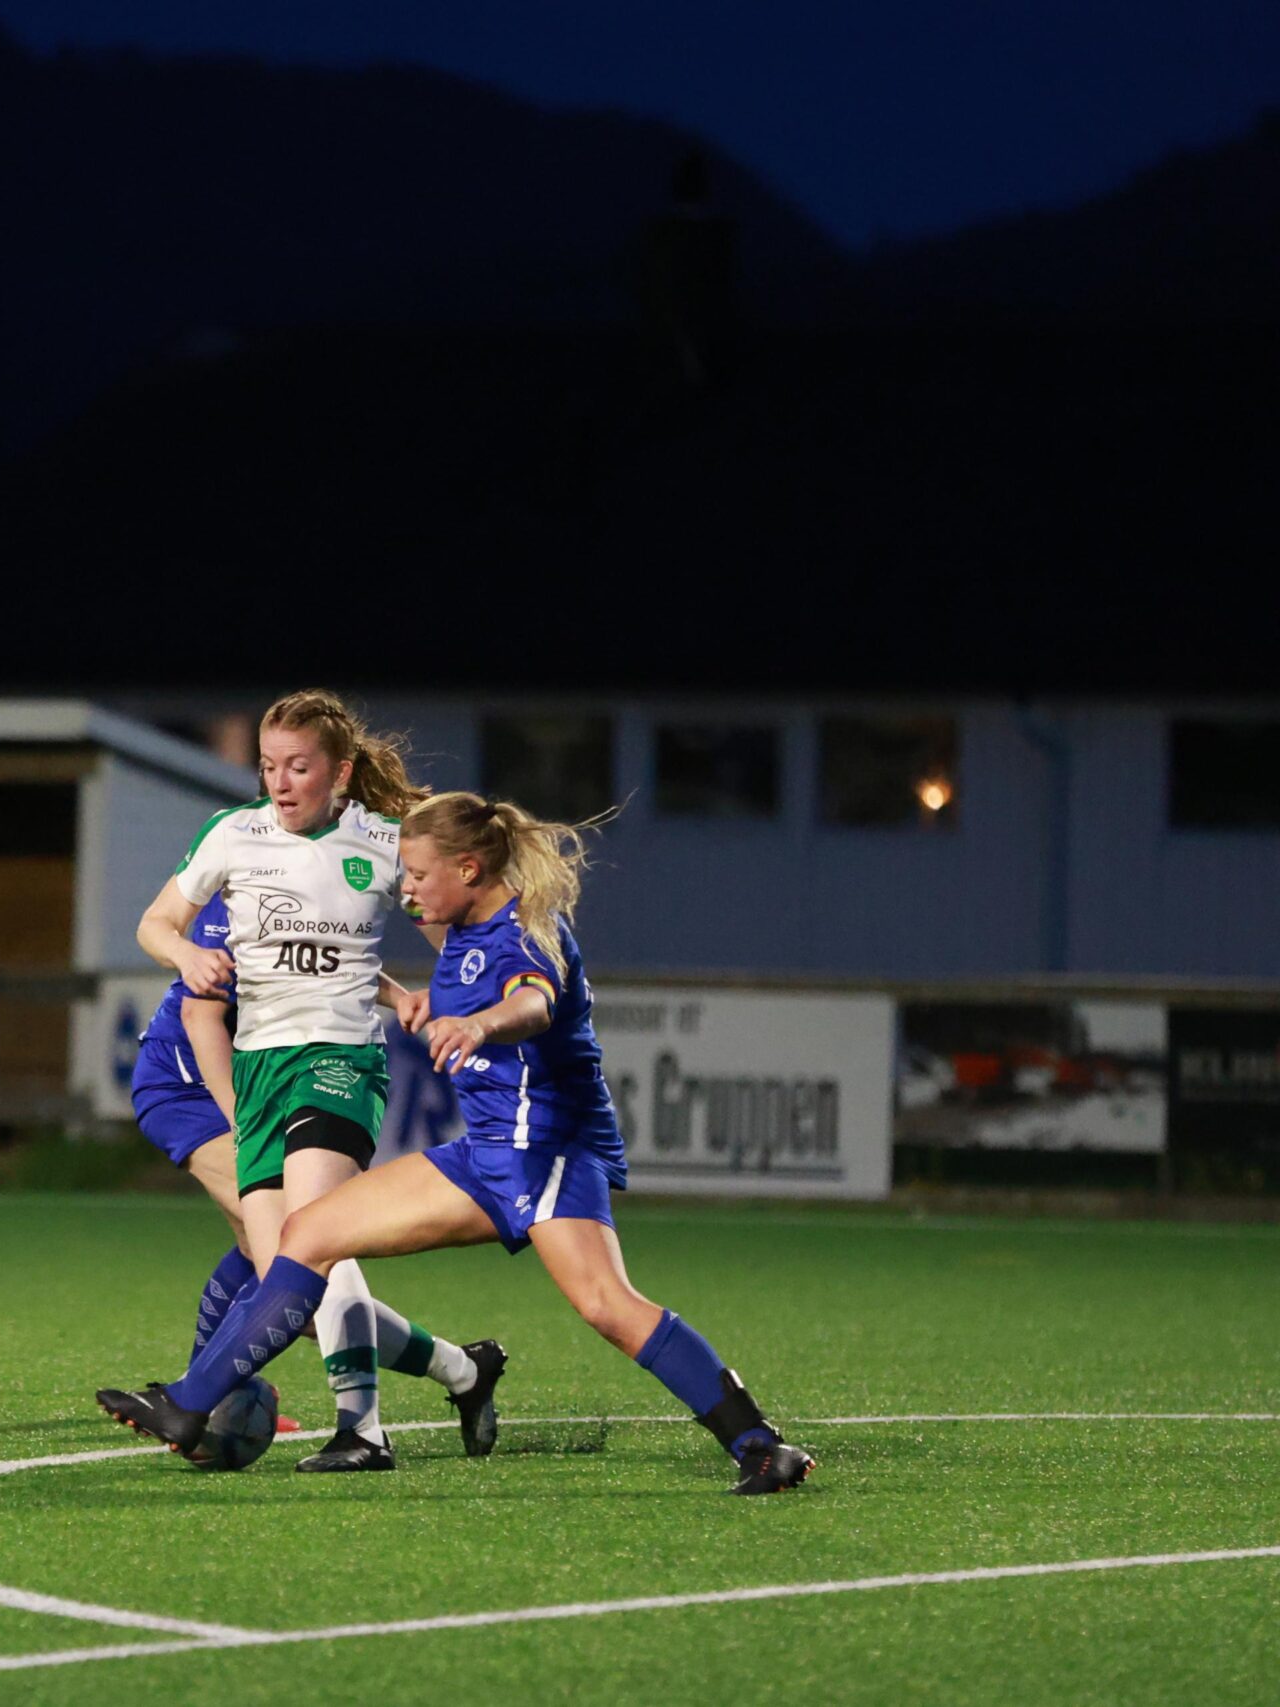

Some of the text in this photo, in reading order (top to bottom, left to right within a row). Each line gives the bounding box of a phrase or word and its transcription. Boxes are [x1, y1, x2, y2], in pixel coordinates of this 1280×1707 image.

[368, 830, 397, 844] NTE
[250, 869, 280, 877] CRAFT
[349, 862, 368, 875] FIL
[274, 919, 373, 934] BJØRØYA AS
[272, 941, 341, 976] AQS
[313, 1083, 345, 1097] CRAFT
[652, 1047, 839, 1171] Gruppen
